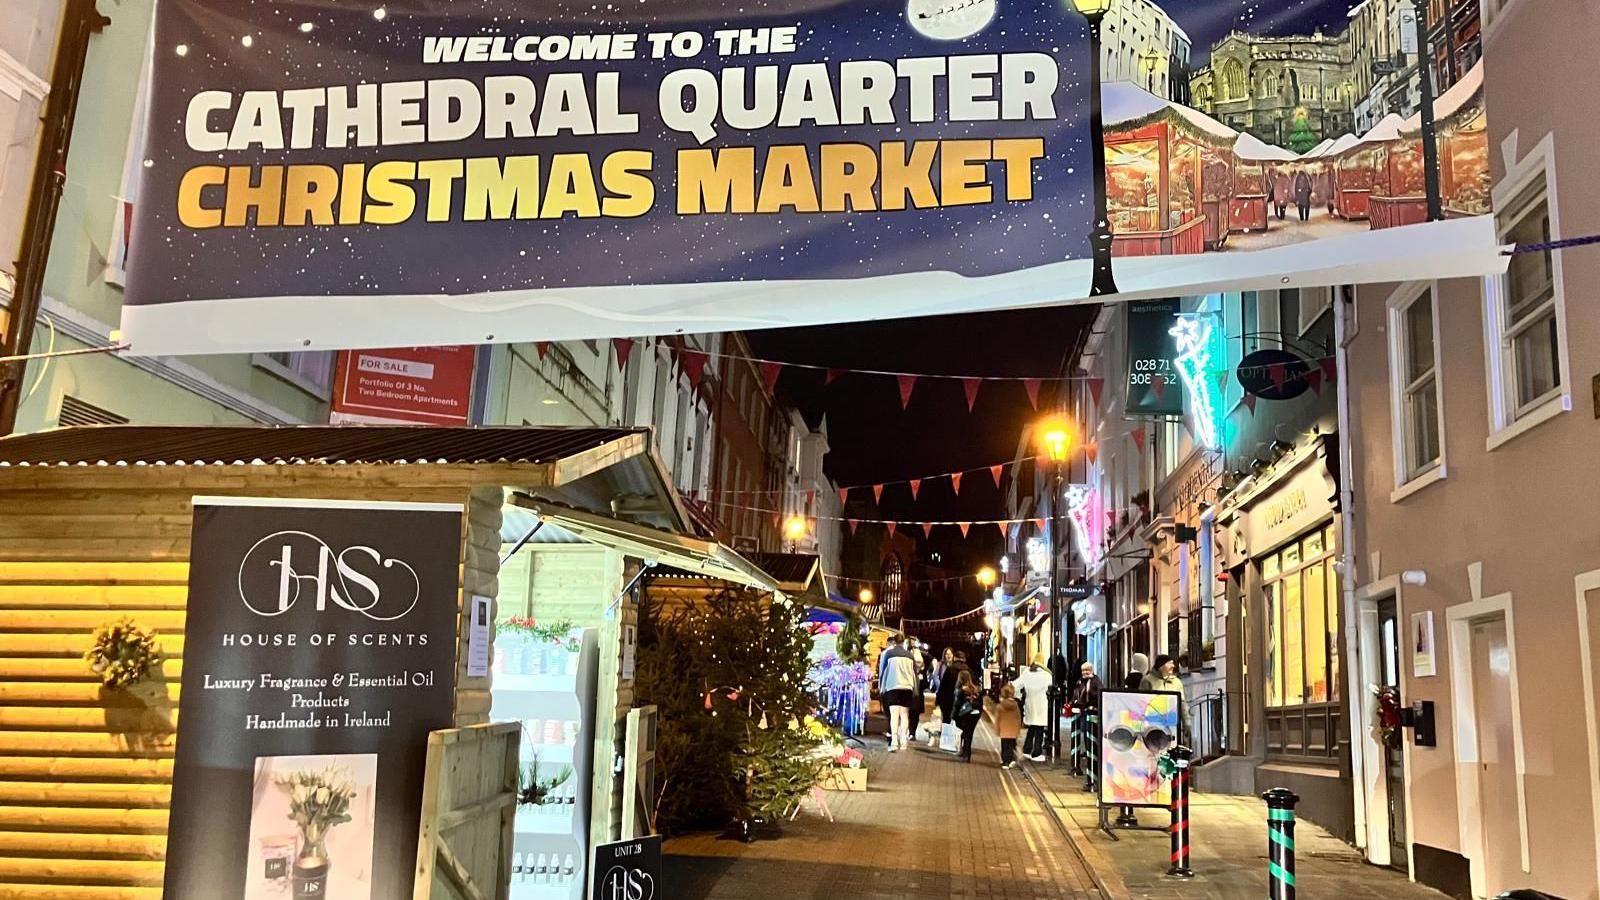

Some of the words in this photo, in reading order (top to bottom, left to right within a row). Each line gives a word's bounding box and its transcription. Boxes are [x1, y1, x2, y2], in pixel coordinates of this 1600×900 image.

[422, 34, 638, 64] WELCOME
[647, 31, 703, 59] TO
[714, 26, 797, 56] THE
[184, 72, 639, 152] CATHEDRAL
[658, 52, 1059, 145] QUARTER
[177, 150, 655, 229] CHRISTMAS
[676, 138, 1045, 215] MARKET
[360, 358, 381, 369] FOR
[384, 360, 409, 373] SALE
[1135, 360, 1156, 371] 028
[1158, 359, 1170, 371] 71
[359, 377, 394, 389] Portfolio
[395, 381, 405, 390] Of
[406, 383, 412, 391] 3
[413, 384, 427, 393] No.
[359, 387, 375, 396] Two
[376, 390, 412, 401] Bedroom
[413, 394, 458, 407] Apartments
[223, 634, 297, 646] HOUSE
[310, 633, 337, 646] OF
[348, 633, 429, 646] SCENTS
[203, 674, 255, 691] Luxury
[259, 673, 328, 691] Fragrance
[331, 673, 344, 687] &
[349, 671, 407, 688] Essential
[412, 670, 433, 687] Oil
[291, 692, 350, 708] Products
[245, 713, 321, 729] Handmade
[325, 714, 338, 728] in
[343, 711, 391, 727] Ireland
[614, 844, 634, 858] UNIT
[634, 843, 642, 854] 28
